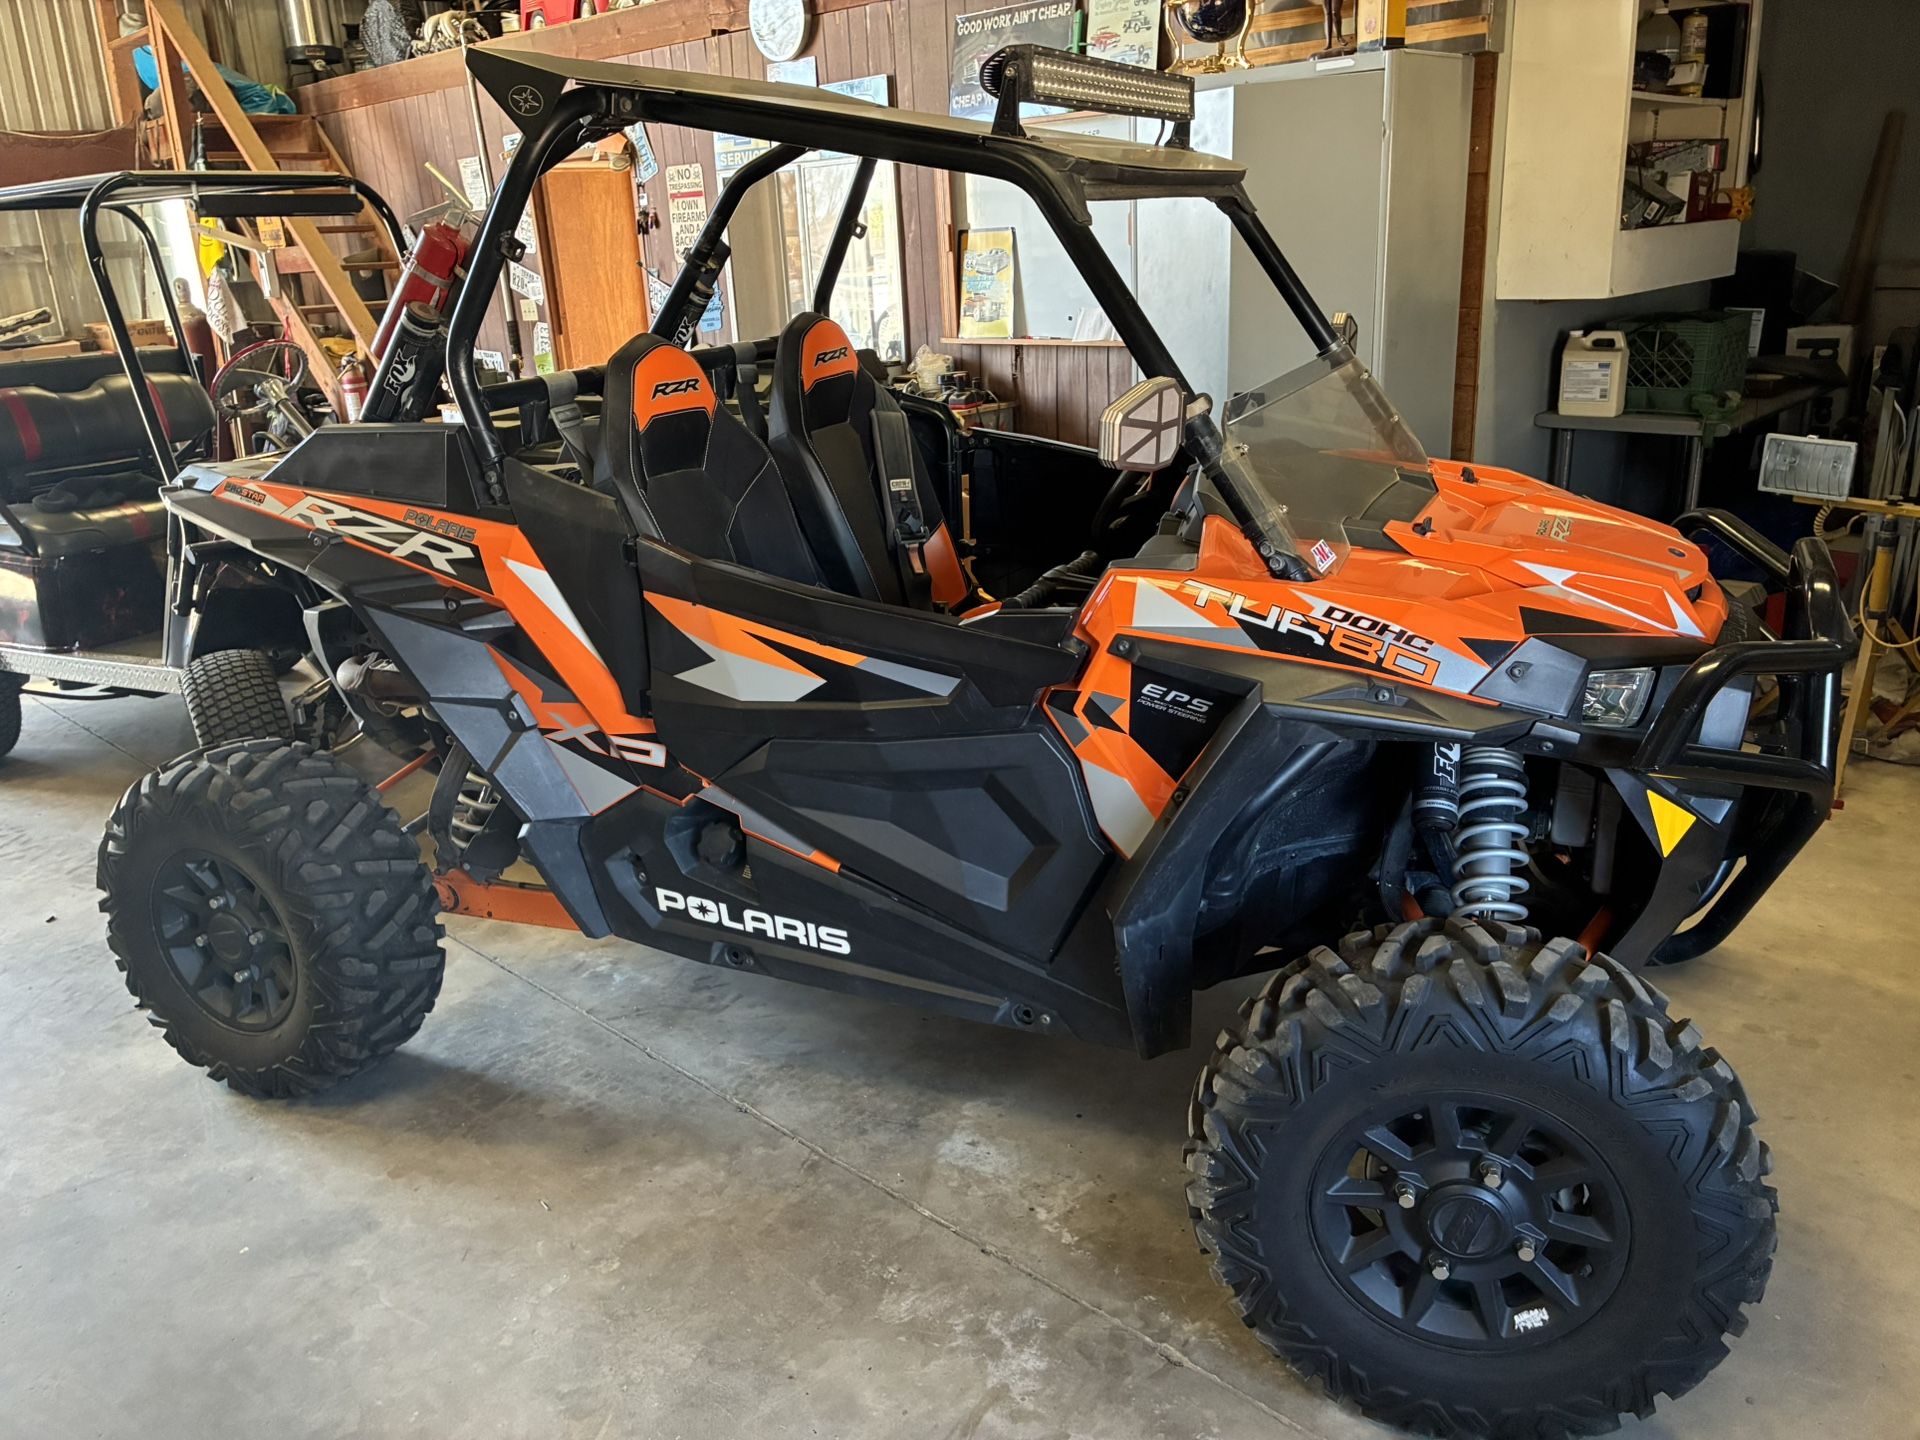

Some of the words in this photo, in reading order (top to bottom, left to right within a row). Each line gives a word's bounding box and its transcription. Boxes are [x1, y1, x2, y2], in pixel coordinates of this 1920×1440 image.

[957, 18, 982, 36] GOOD
[982, 14, 1011, 31] WORK
[1012, 8, 1037, 26] AIN'T
[1038, 2, 1071, 20] CHEAP.
[952, 94, 982, 109] CHEAP
[669, 181, 702, 190] TRESPASSING
[677, 168, 691, 180] NO
[672, 211, 706, 223] FIREARMS
[680, 200, 699, 211] OWN
[679, 222, 696, 234] AND
[814, 346, 848, 369] RZR
[383, 348, 417, 396] FOX
[650, 378, 700, 401] RZR
[278, 495, 476, 576] RZR
[402, 508, 478, 543] POLARIS
[1183, 578, 1441, 686] TURBO
[1321, 604, 1436, 653] DOHC
[1137, 698, 1168, 712] POWER
[1167, 708, 1207, 724] STEERING
[1141, 683, 1214, 712] EPS
[1433, 741, 1461, 785] FO
[655, 887, 851, 956] POLARIS
